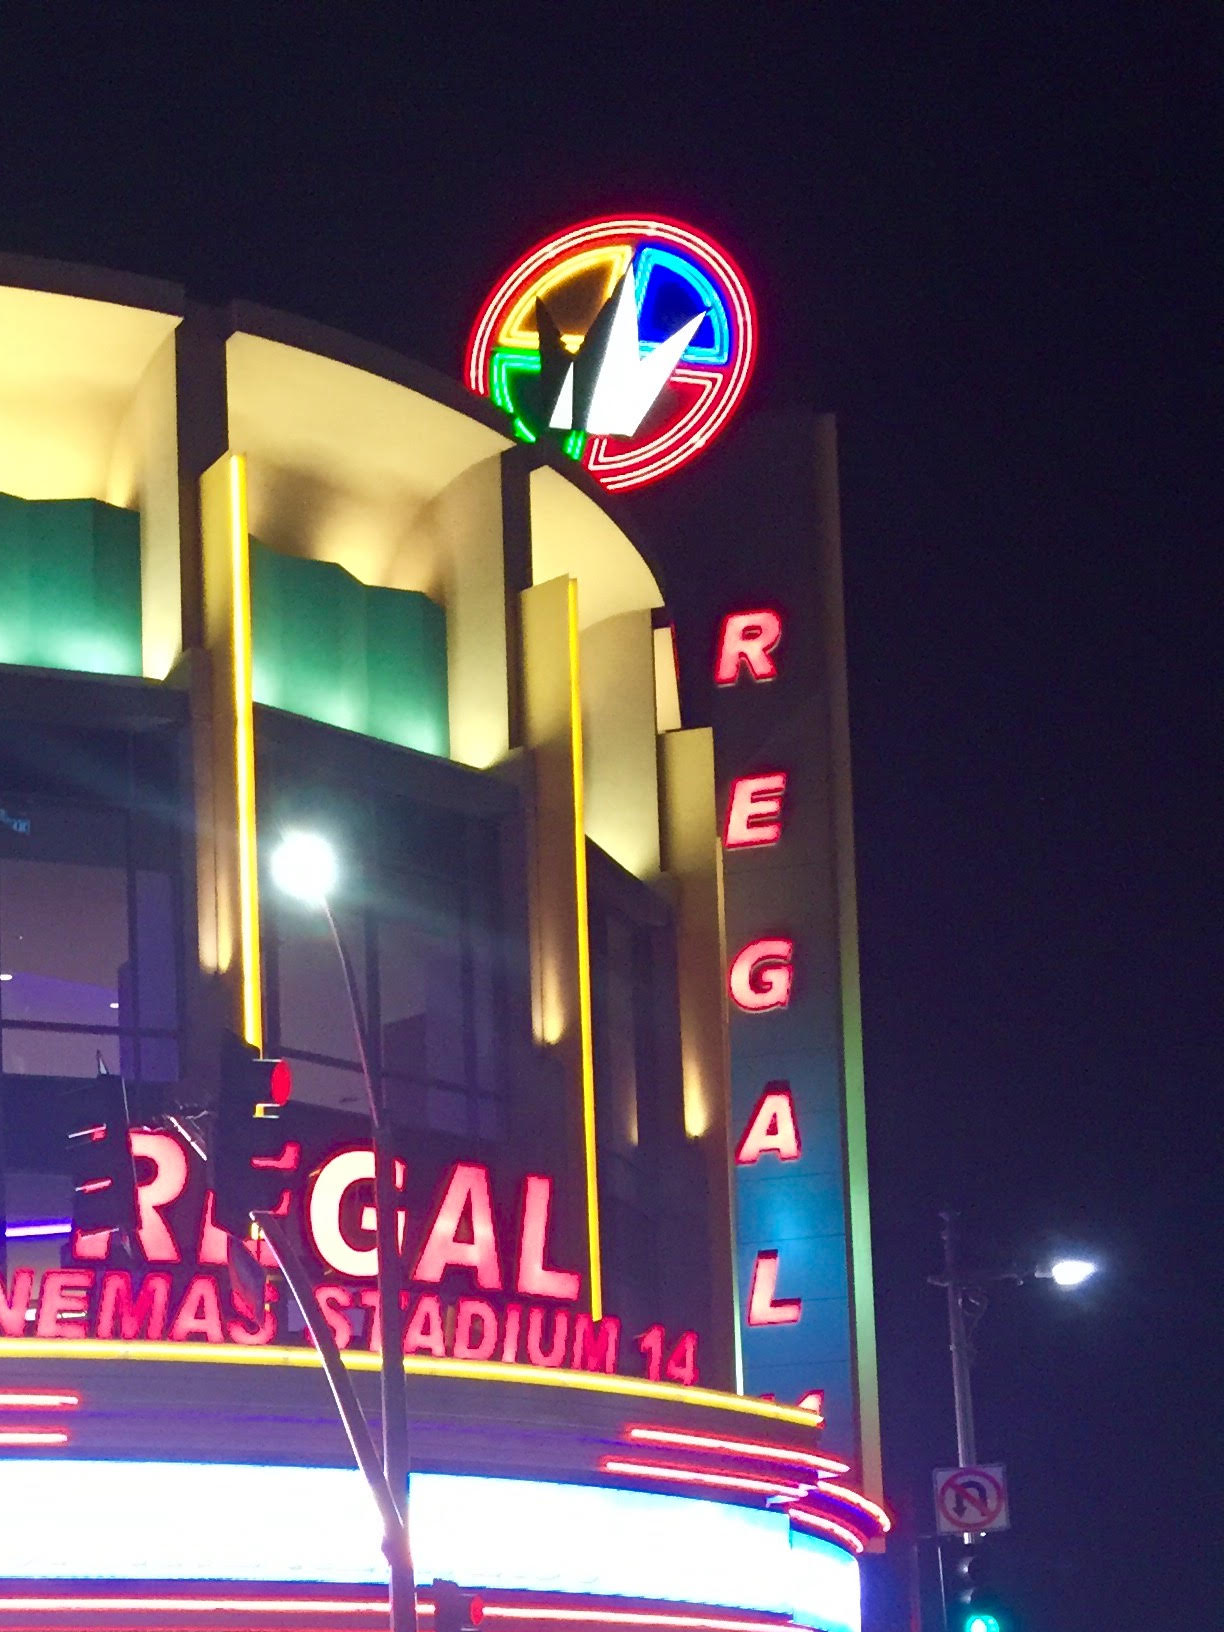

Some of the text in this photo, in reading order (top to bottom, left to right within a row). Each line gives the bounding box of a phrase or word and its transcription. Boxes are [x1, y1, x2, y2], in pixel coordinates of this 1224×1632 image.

[714, 608, 802, 1327] REGAL
[306, 1285, 621, 1374] STADIUM
[638, 1322, 701, 1387] 14
